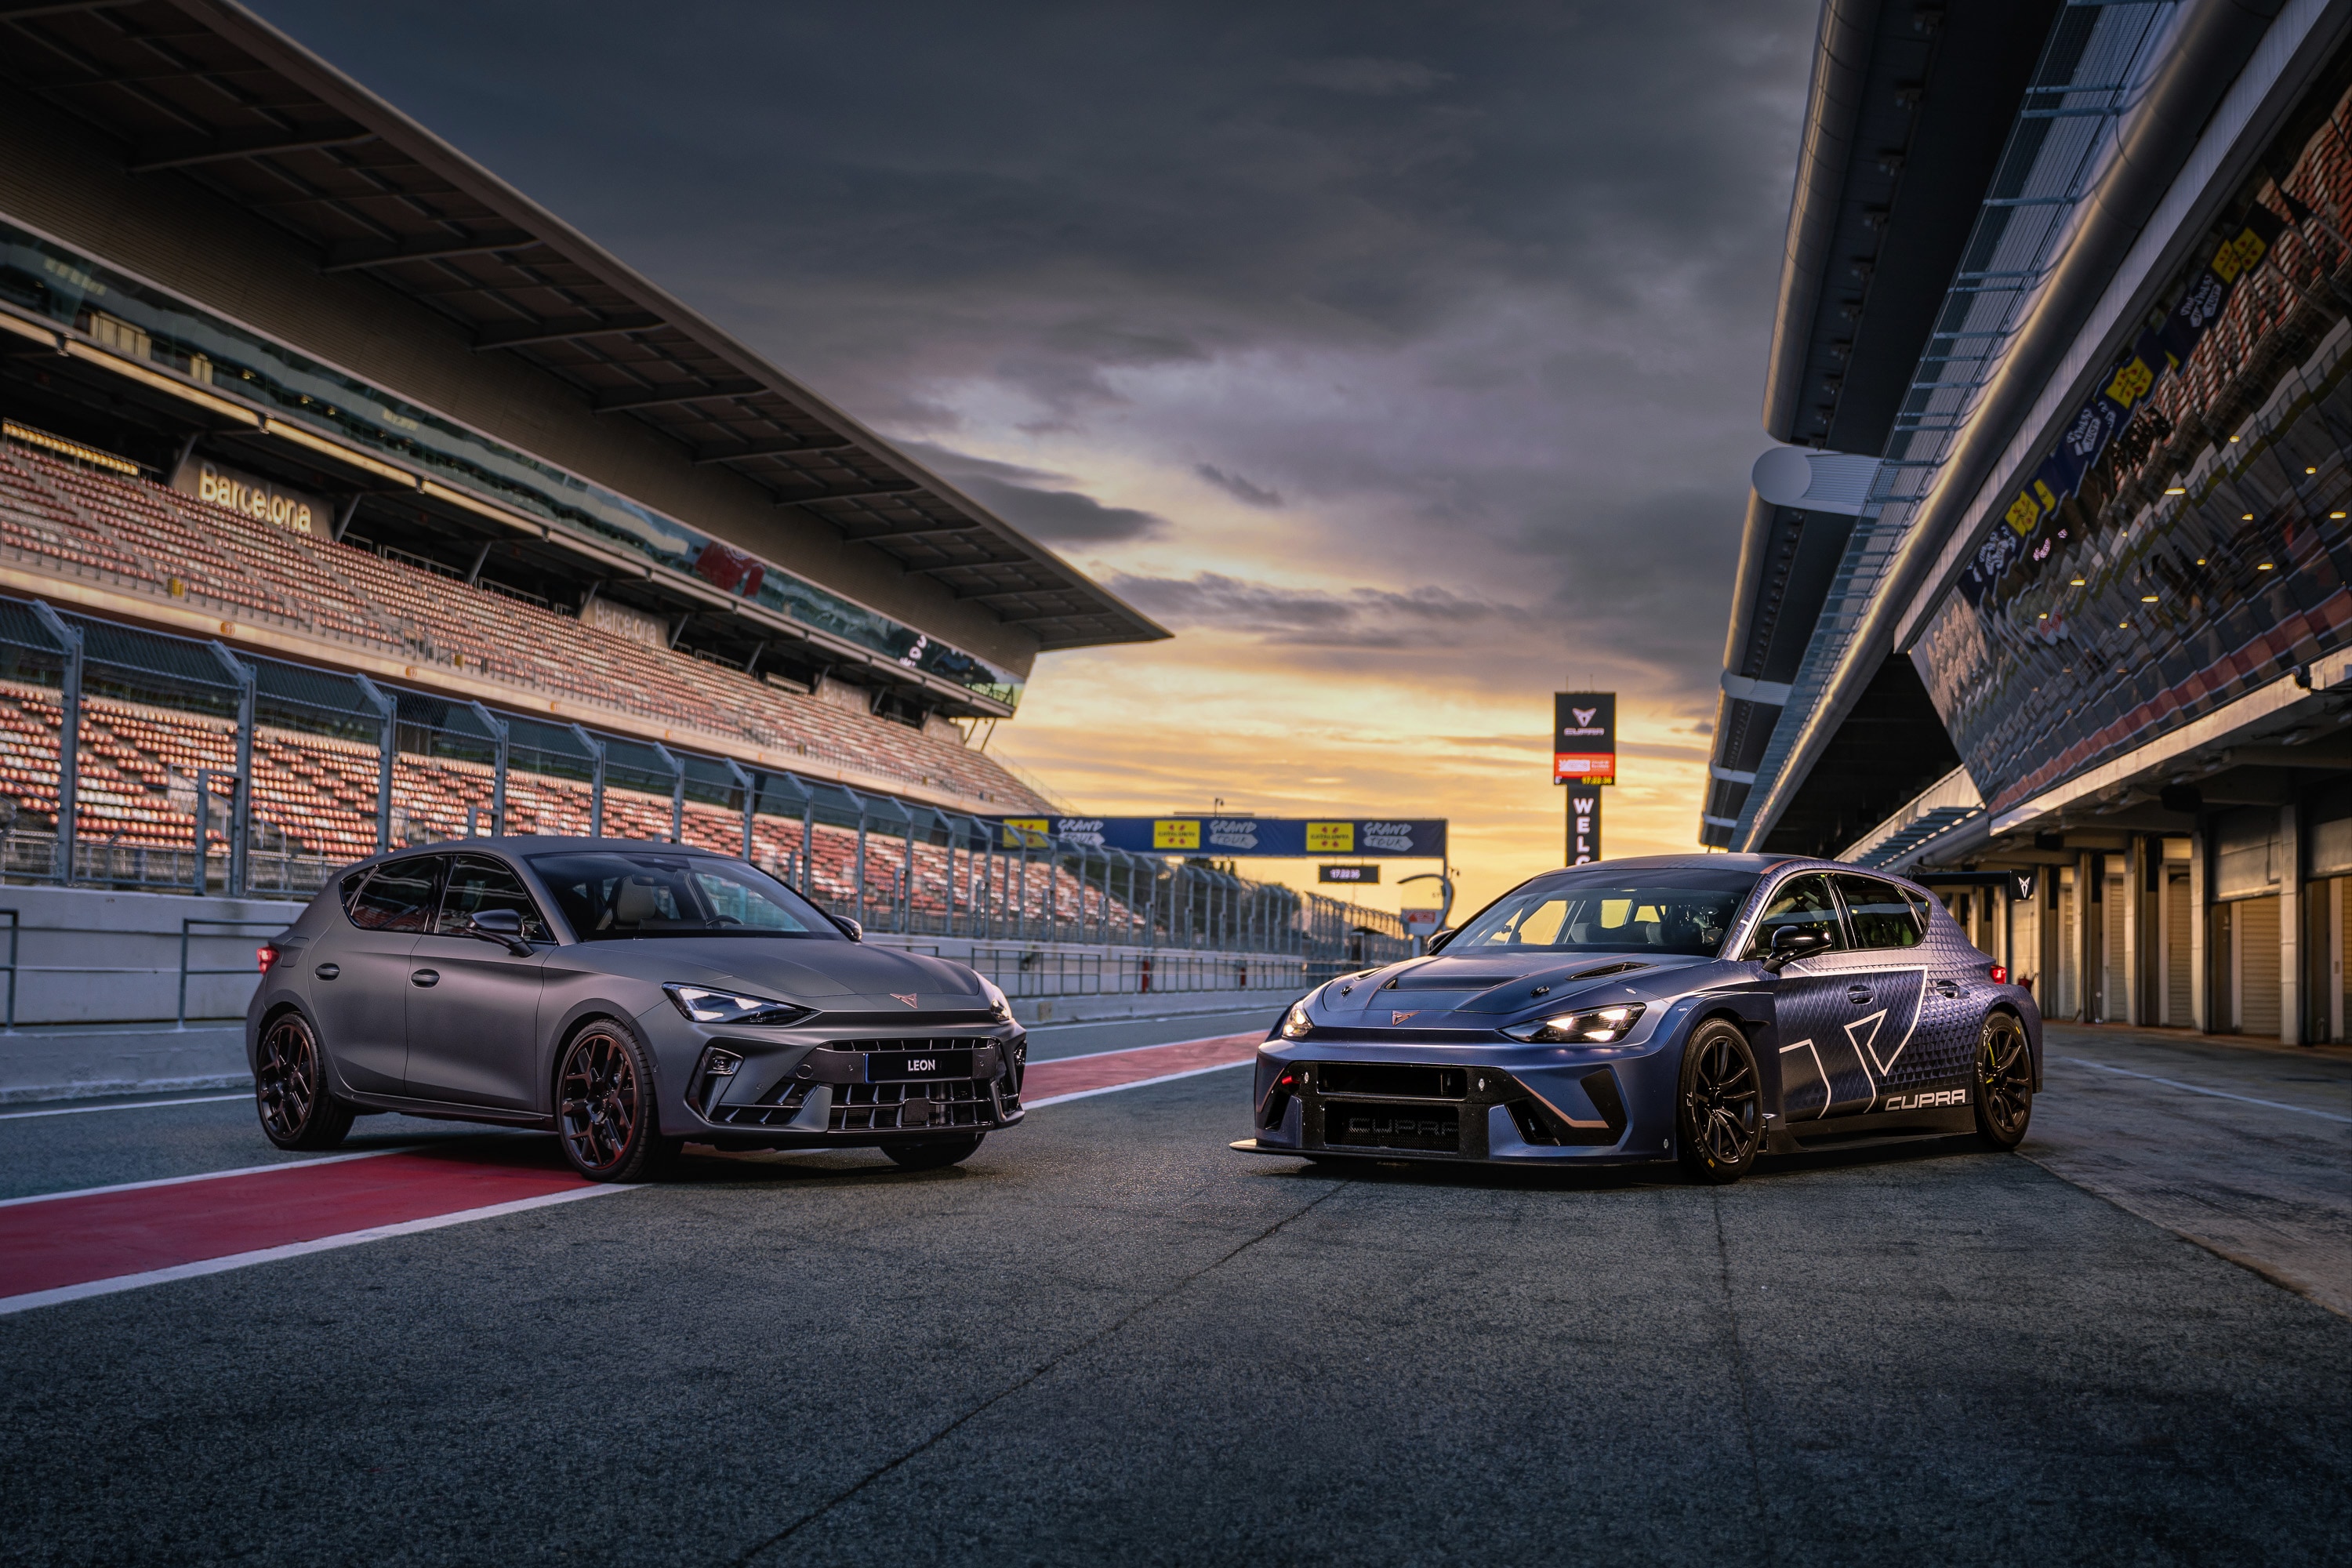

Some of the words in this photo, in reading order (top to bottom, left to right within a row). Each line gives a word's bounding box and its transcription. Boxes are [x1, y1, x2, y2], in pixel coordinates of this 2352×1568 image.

[198, 462, 312, 534] Barcelona
[596, 600, 657, 644] Barcelona
[1563, 728, 1605, 736] CUPRA
[1058, 818, 1104, 832] GRAND
[1210, 820, 1258, 833] GRAND
[1363, 822, 1412, 836] GRAND
[1215, 835, 1249, 847] TOUR
[1370, 837, 1404, 848] TOUR
[907, 1058, 936, 1072] LEON
[1885, 1088, 1966, 1112] CUPRA
